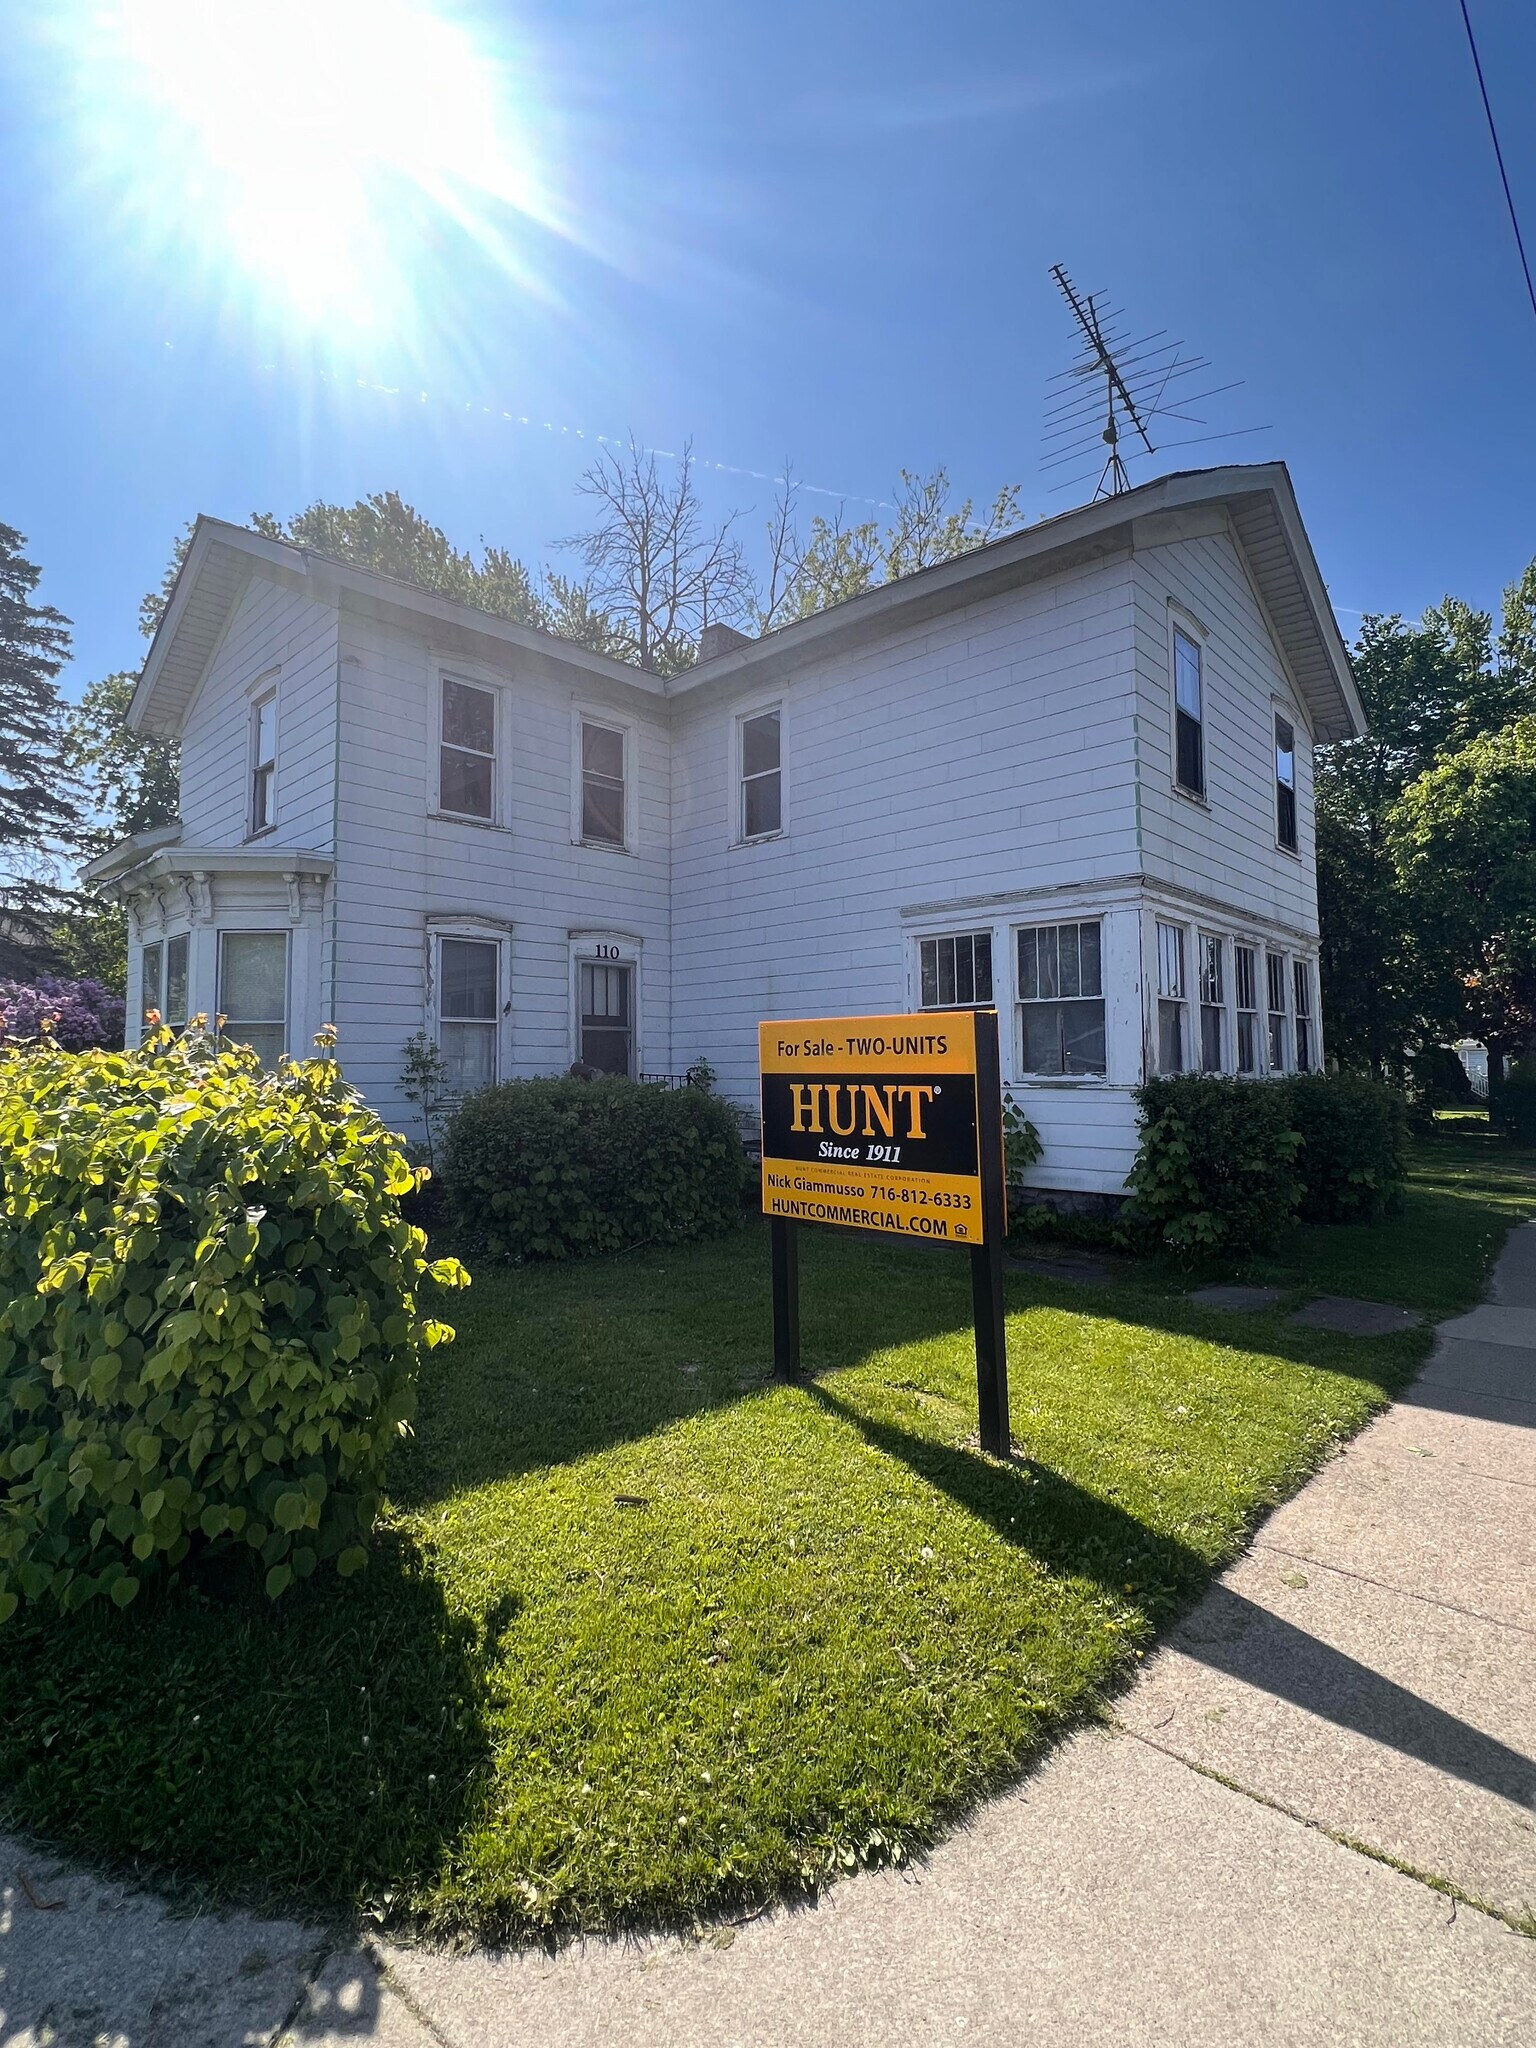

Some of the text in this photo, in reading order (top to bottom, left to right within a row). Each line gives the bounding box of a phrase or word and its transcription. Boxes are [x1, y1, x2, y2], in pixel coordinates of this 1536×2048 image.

[595, 944, 620, 959] 110
[778, 1040, 799, 1057] For
[803, 1038, 834, 1056] Sale
[846, 1035, 948, 1055] TWO-UNITS
[818, 1141, 901, 1164] Since 1911
[886, 1175, 931, 1184] CORPORATION
[767, 1173, 972, 1210] Nick Giammusso 716-812-6333
[772, 1198, 948, 1236] HUNTCOMMERCIAL.COM
